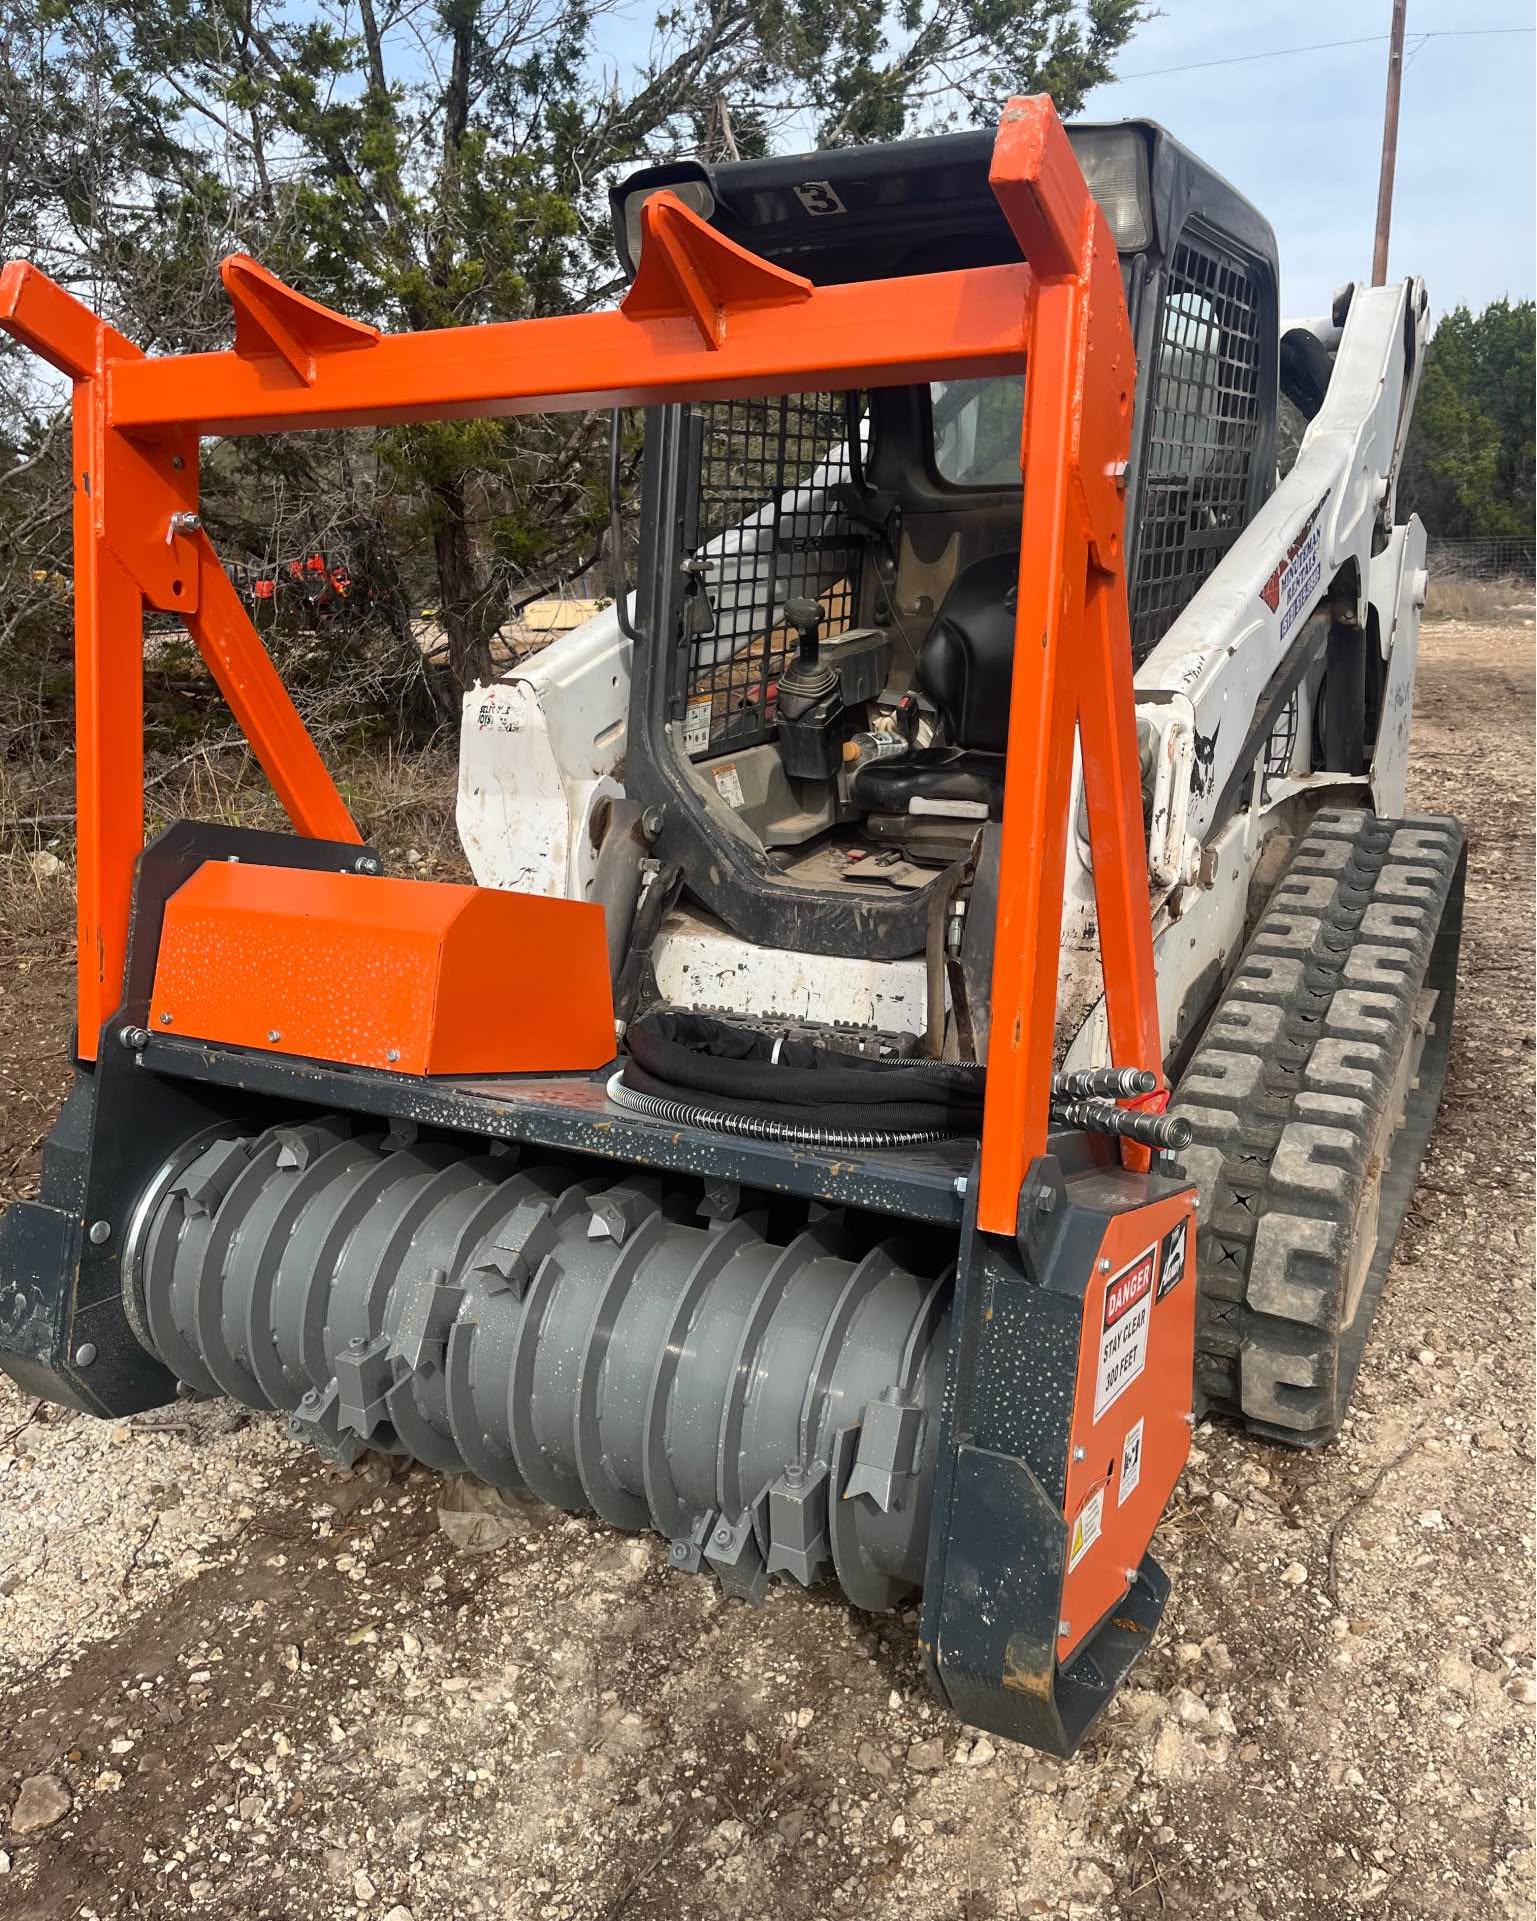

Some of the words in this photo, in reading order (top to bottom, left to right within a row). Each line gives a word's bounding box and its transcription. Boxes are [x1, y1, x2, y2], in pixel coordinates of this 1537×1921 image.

[800, 184, 838, 212] 3
[1287, 552, 1317, 605] RENTALS
[1108, 1264, 1150, 1318] DANGER
[1103, 1331, 1122, 1363] STAY
[1123, 1308, 1146, 1340] CLEAR
[1105, 1364, 1119, 1391] 300
[1119, 1345, 1138, 1377] FEET
